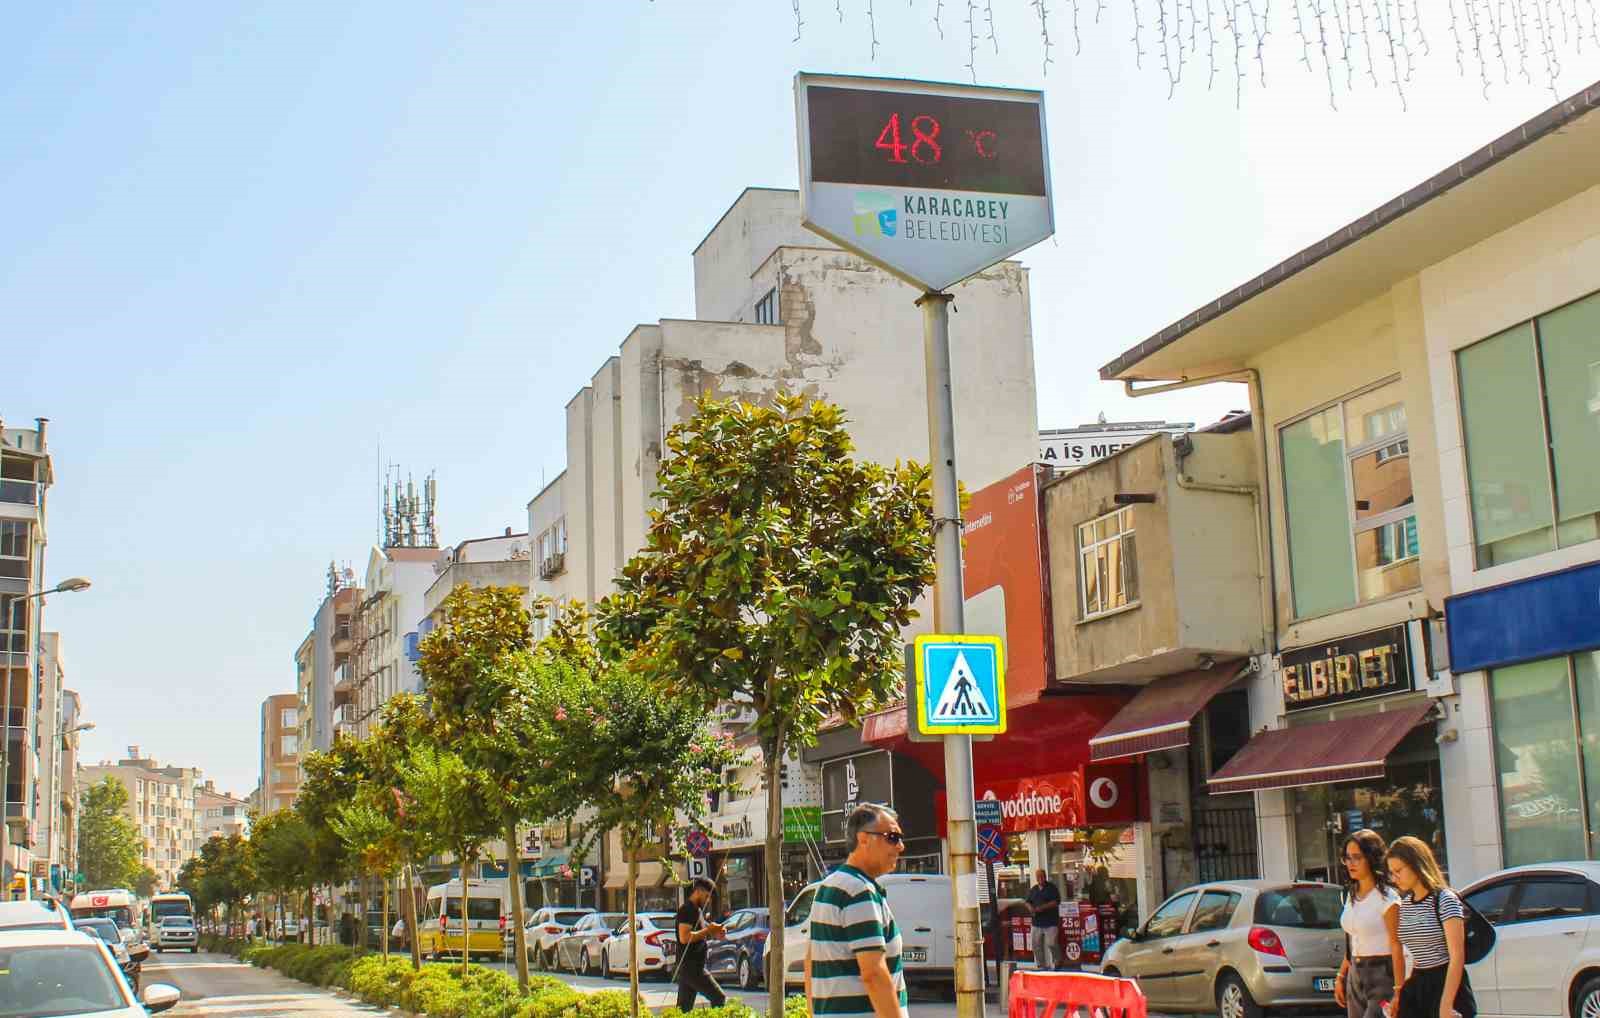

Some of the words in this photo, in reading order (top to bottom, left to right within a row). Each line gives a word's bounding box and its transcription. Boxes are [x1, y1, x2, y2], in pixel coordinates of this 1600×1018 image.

[875, 112, 942, 164] 48
[903, 195, 1009, 220] KARACABEY
[1063, 442, 1084, 462] İŞ
[1001, 790, 1061, 818] vodafone
